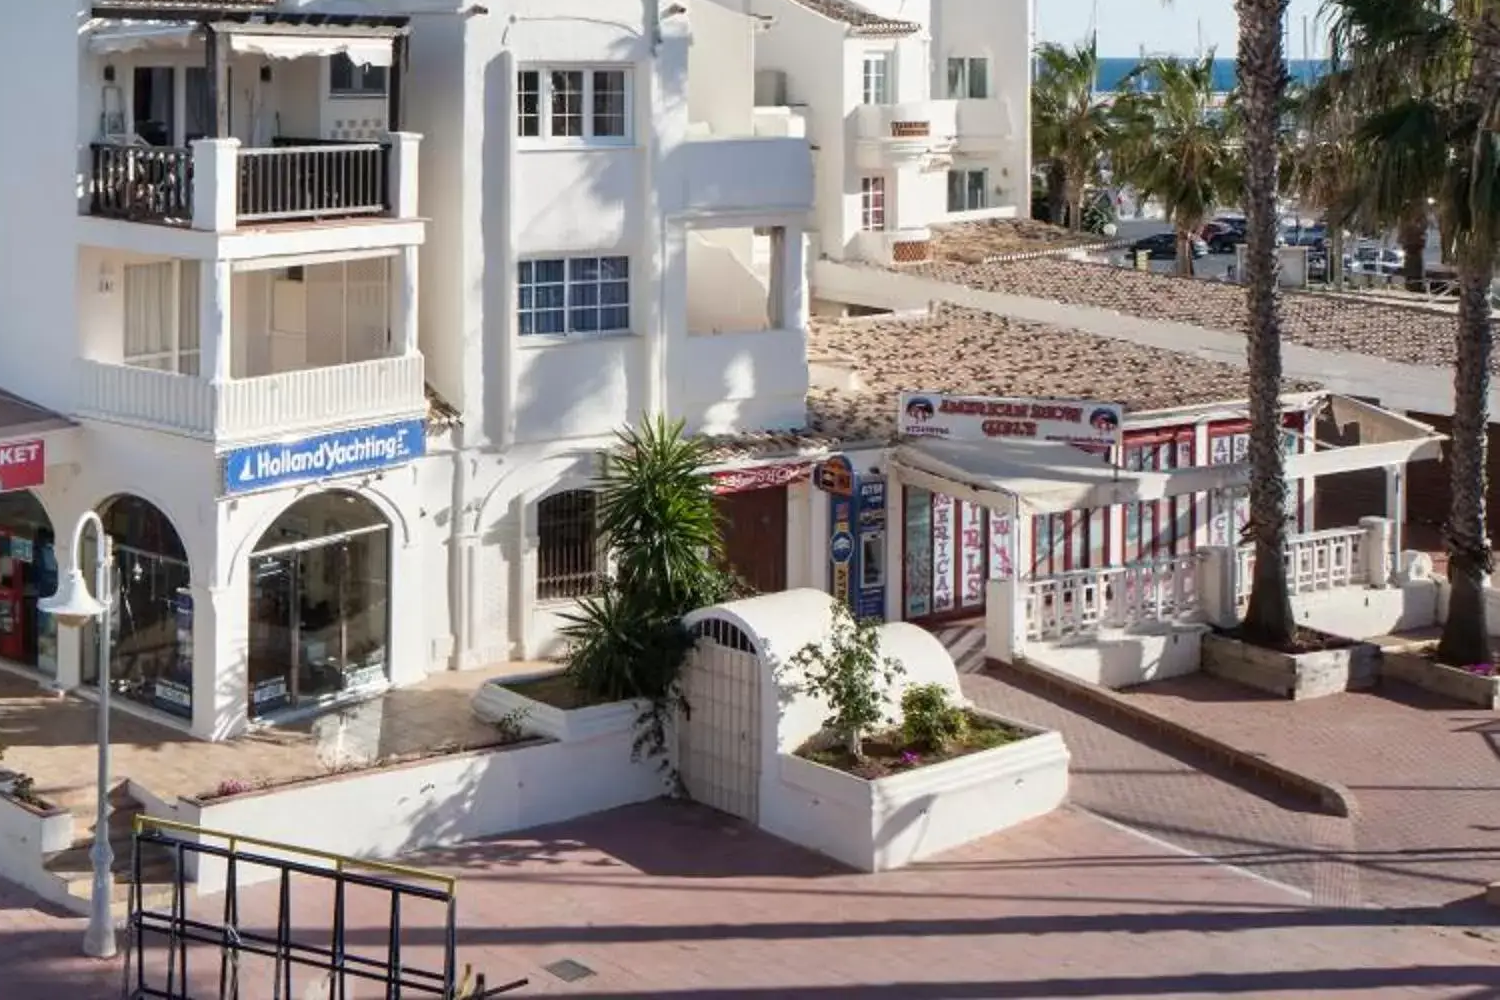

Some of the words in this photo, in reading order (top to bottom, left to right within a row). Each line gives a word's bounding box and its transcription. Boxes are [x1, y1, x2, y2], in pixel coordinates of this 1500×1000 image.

[938, 400, 1029, 417] AMERICAN
[257, 435, 397, 480] HollandYachting
[933, 491, 951, 609] MERICAN
[964, 501, 984, 601] IRLS
